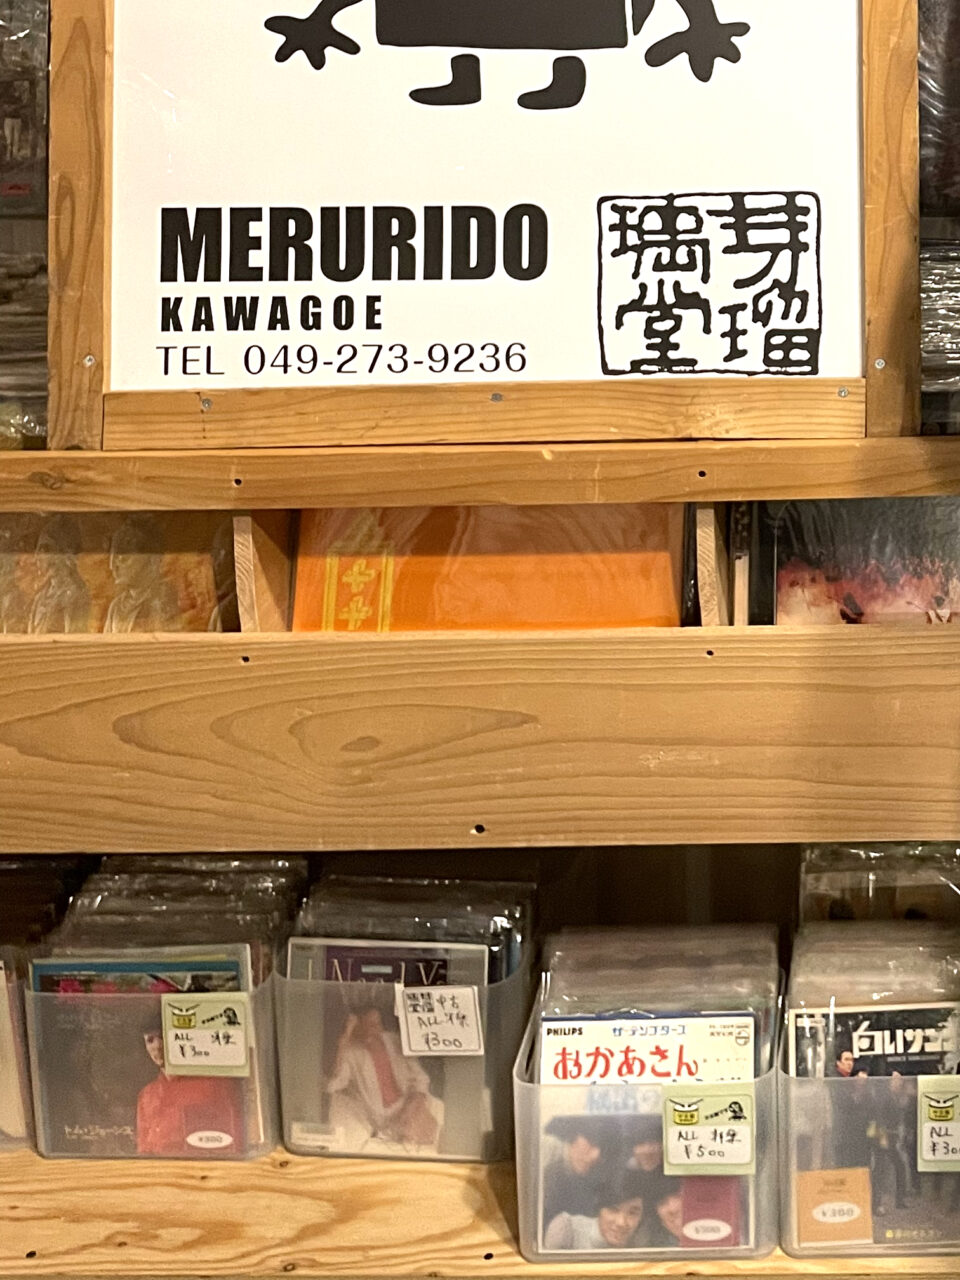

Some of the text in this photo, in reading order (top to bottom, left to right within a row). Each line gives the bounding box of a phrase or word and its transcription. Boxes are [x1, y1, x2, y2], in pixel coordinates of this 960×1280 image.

[159, 203, 549, 283] MERURIDO
[161, 295, 383, 332] KAWAGOE
[156, 342, 527, 376] TEL 049-273-9236
[546, 1027, 583, 1036] PHILIPS
[553, 1044, 699, 1080] おかあさん
